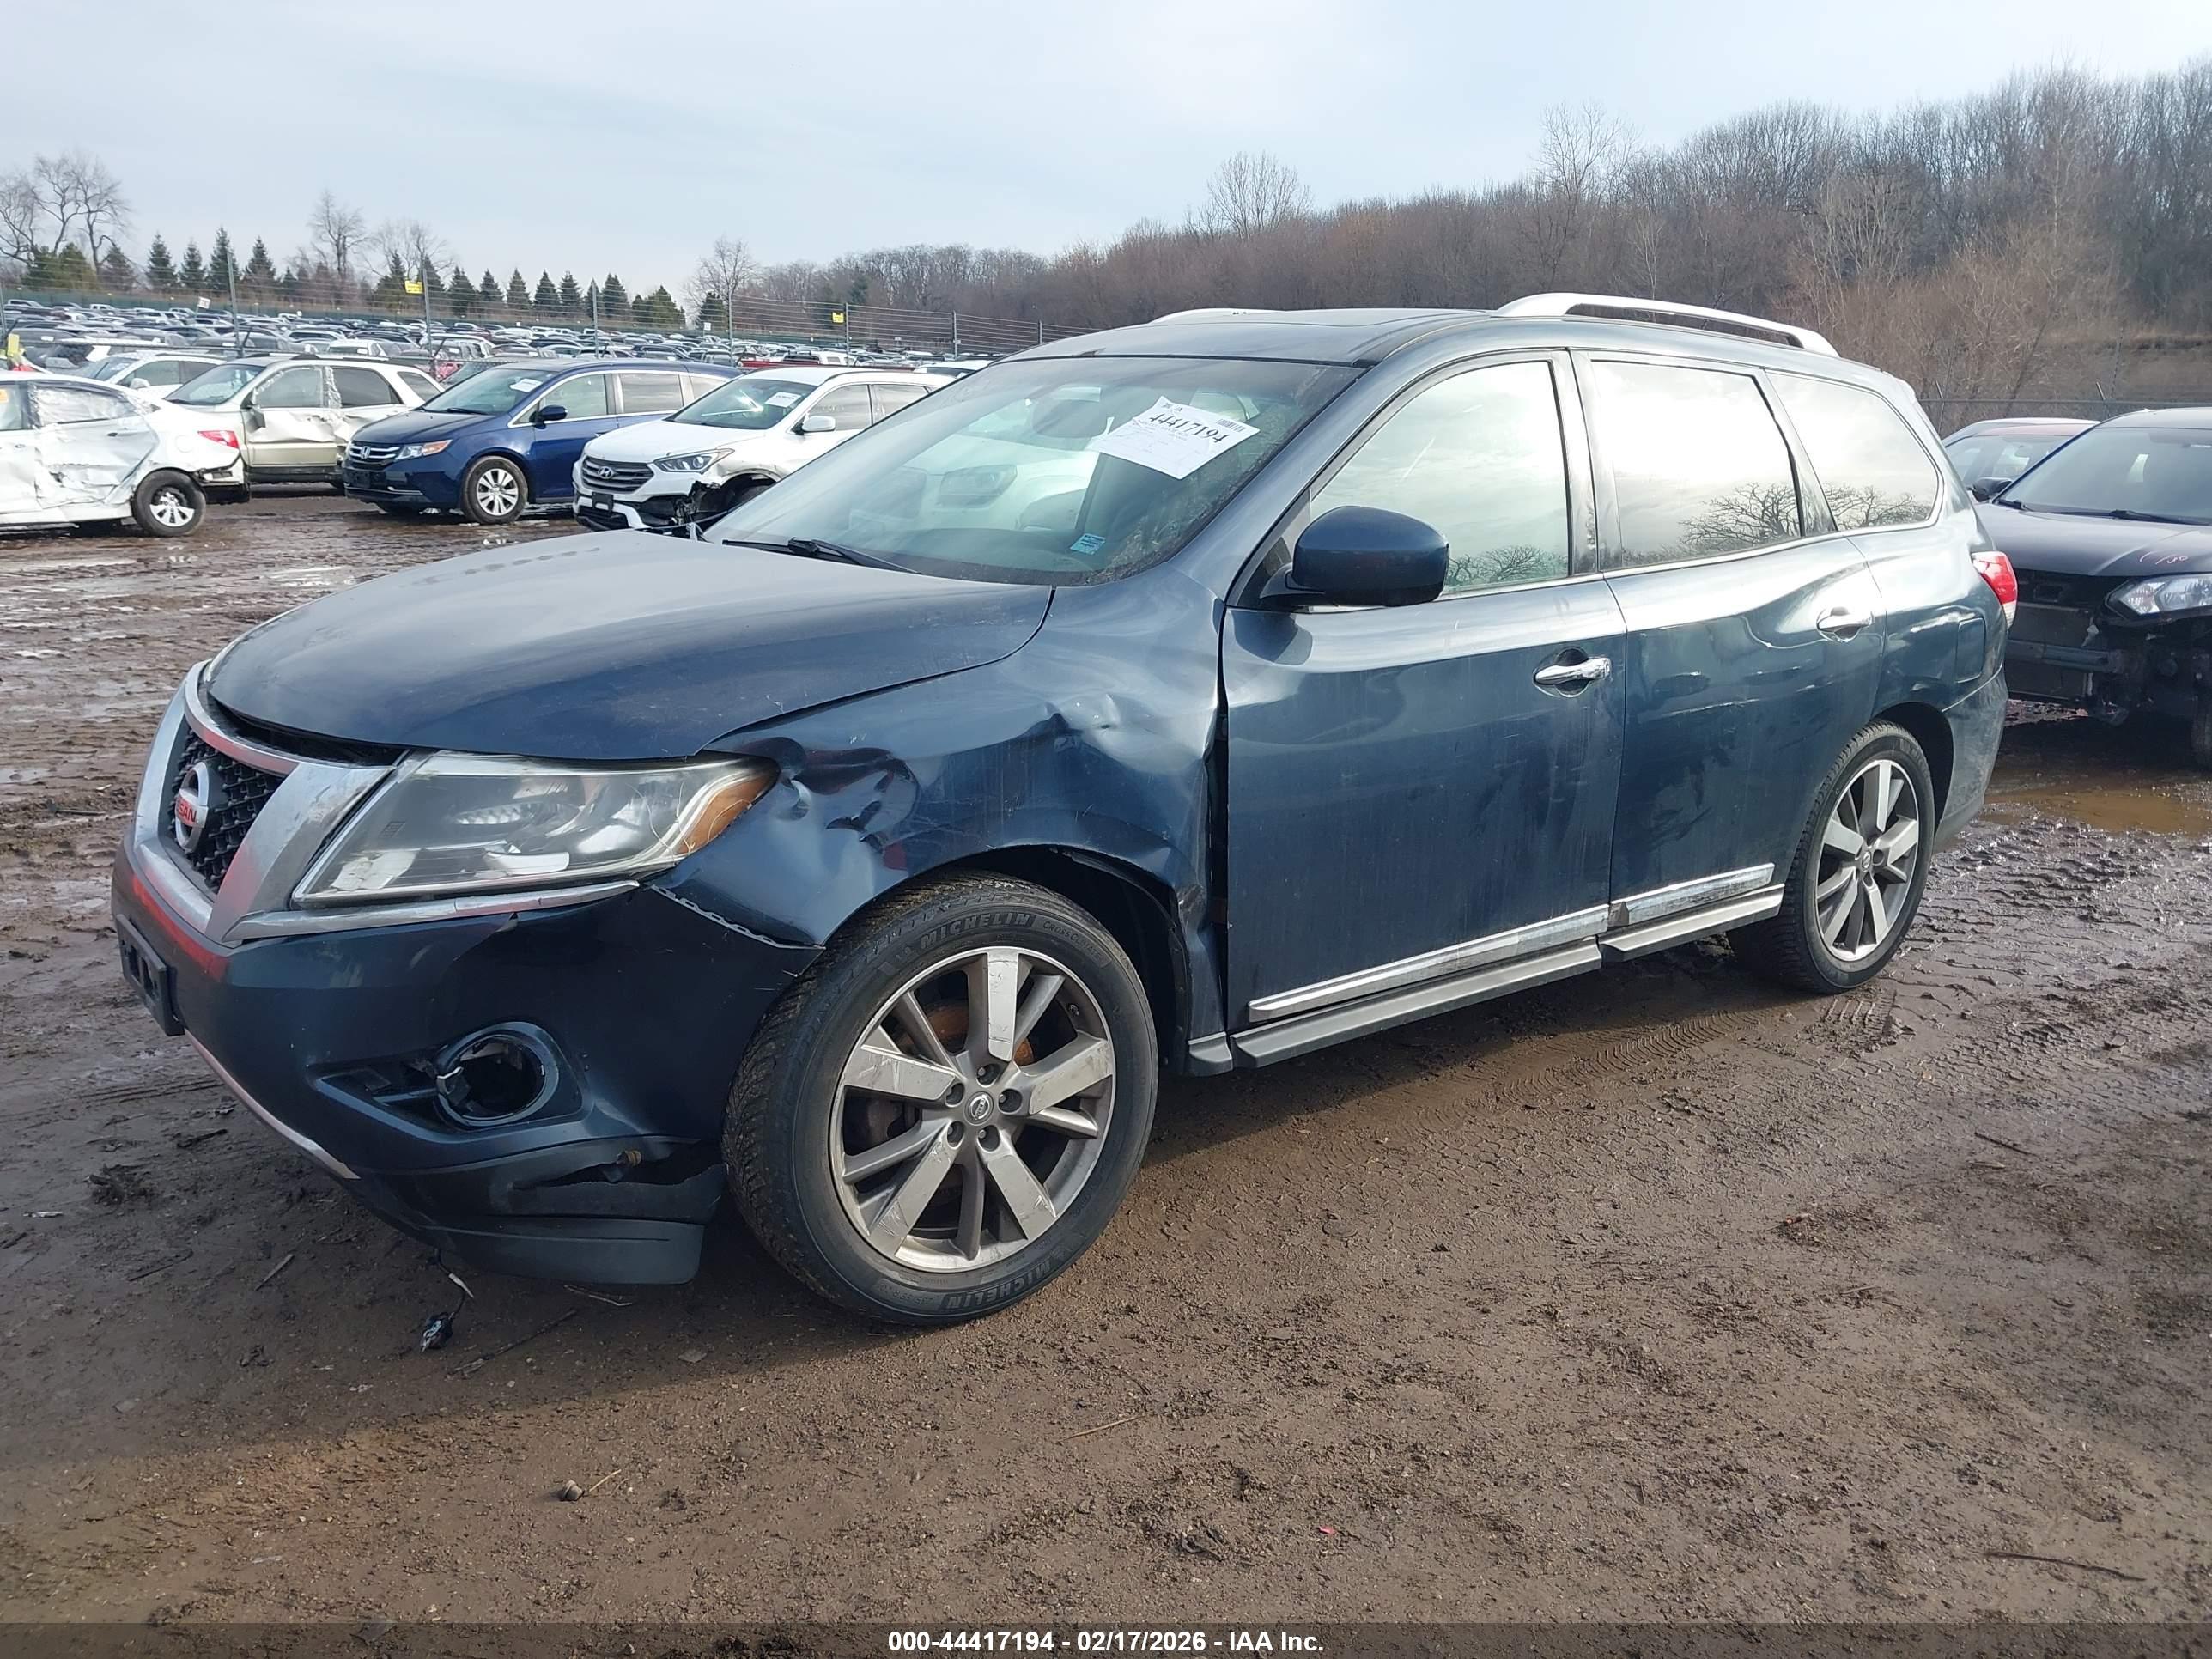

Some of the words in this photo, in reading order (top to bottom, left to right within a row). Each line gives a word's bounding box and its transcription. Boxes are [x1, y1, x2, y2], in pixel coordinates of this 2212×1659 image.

[1149, 413, 1230, 444] 44417194
[920, 912, 1032, 949] MICHELIN
[946, 1260, 1051, 1310] MICHELIN
